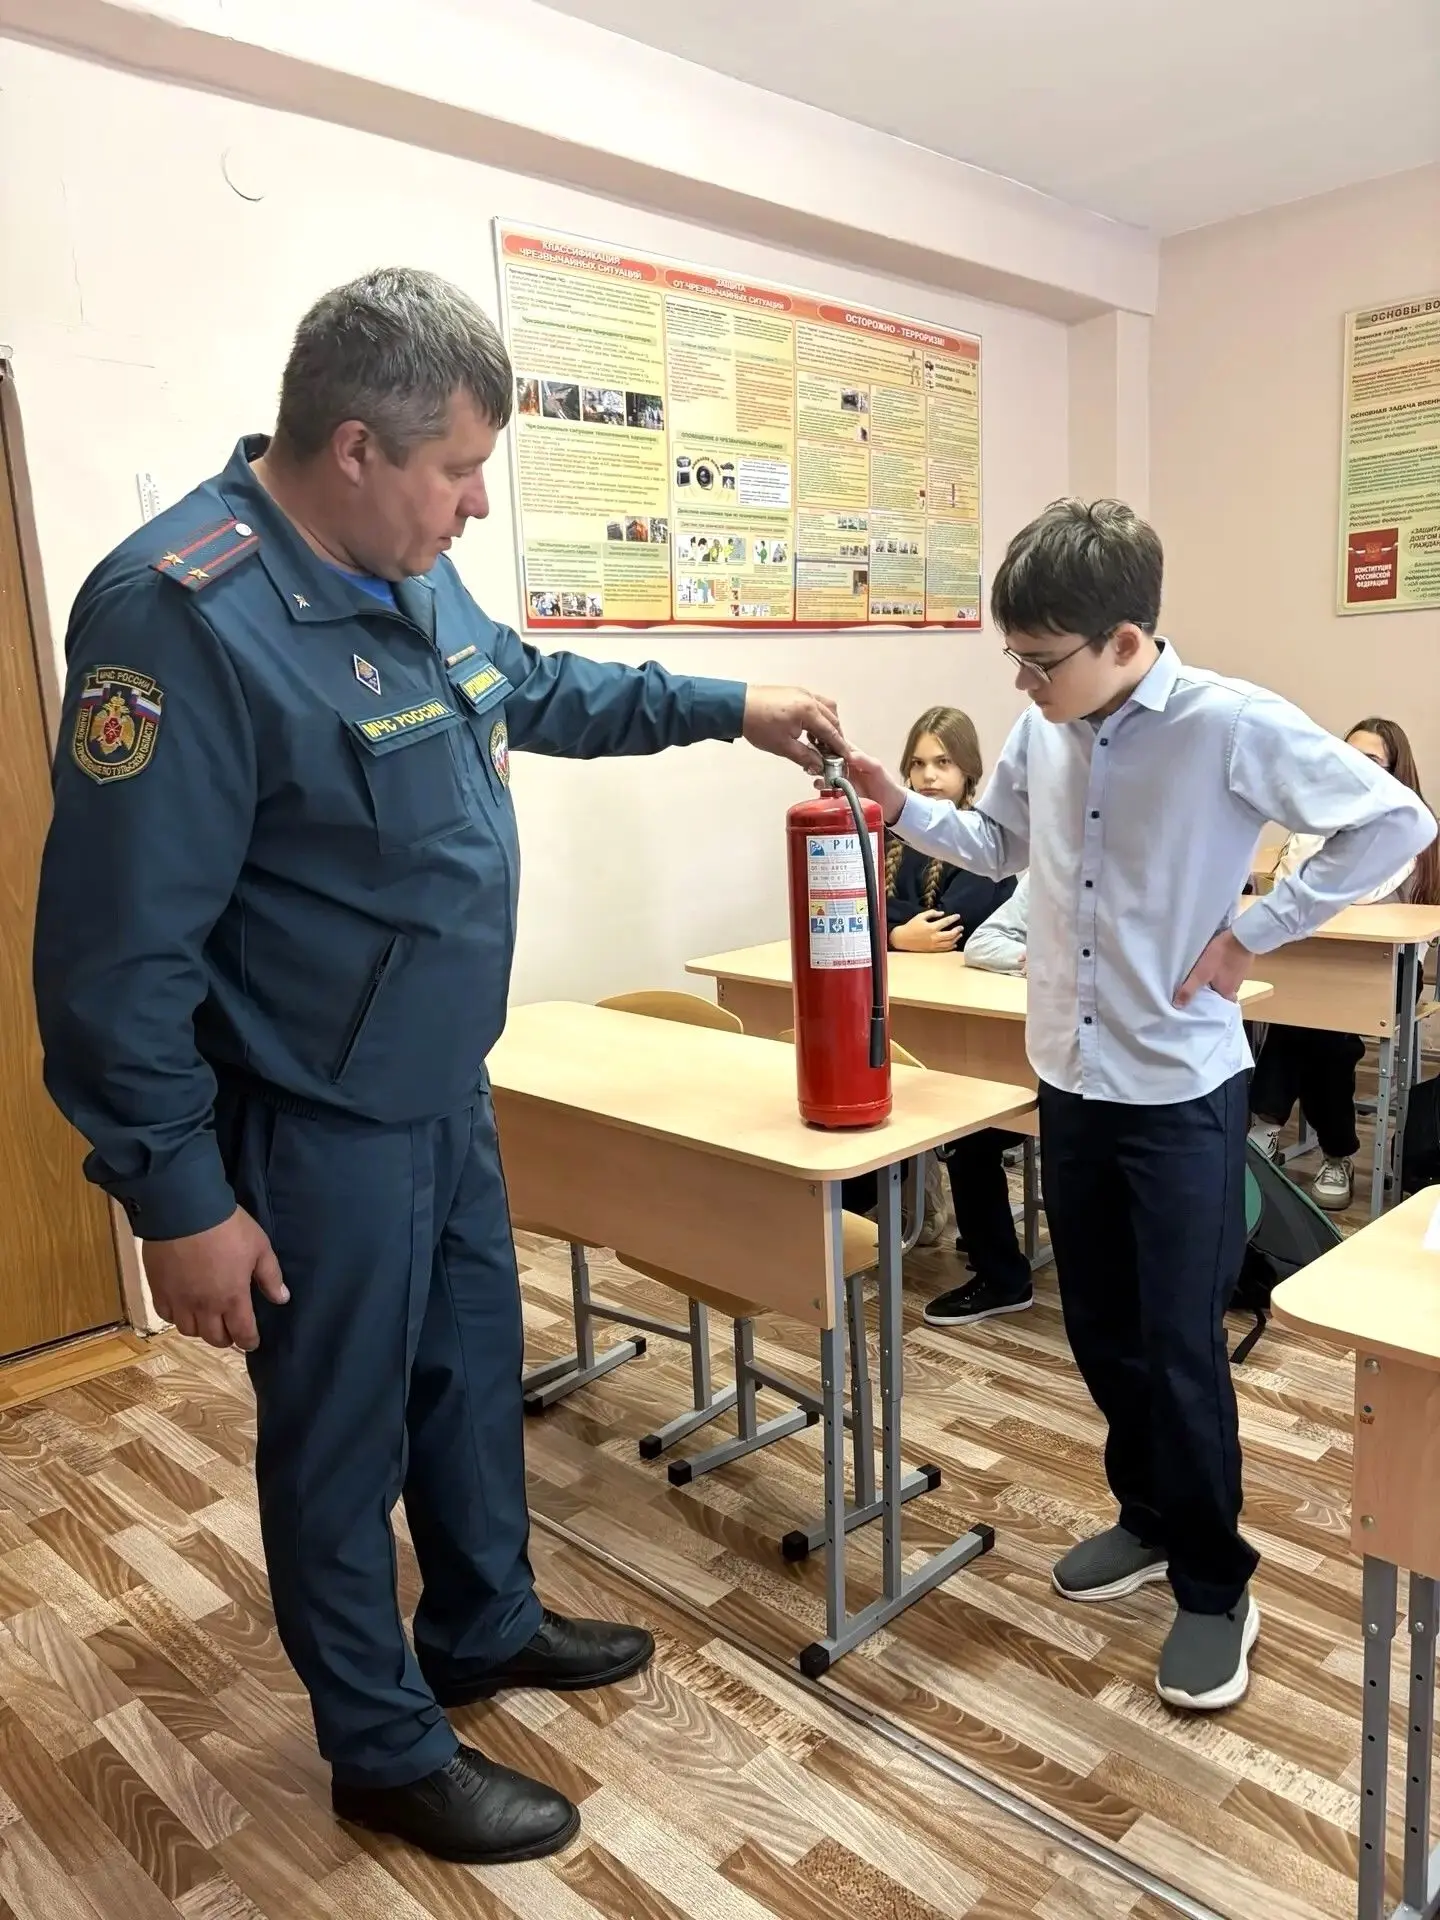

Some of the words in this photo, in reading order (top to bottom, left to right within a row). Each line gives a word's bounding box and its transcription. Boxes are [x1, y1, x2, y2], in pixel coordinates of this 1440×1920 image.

[542, 240, 621, 265] КЛАССИФИКАЦИЯ
[519, 248, 599, 271] ЧРЕЗВЫЧАЙНЫХ
[599, 265, 642, 280] СИТУАЦИЙ
[673, 280, 685, 289] ОТ
[685, 281, 748, 302] ЧРЕЗВЫЧАЙНЫХ
[748, 295, 785, 310] СИТУАЦИЙ
[1370, 304, 1421, 322] ОСНОВЫ
[1425, 300, 1440, 311] ВО
[845, 313, 896, 334] ОСТОРОЖНО
[1350, 407, 1388, 419] ОСНОВНАЯ
[1388, 402, 1416, 412] ЗАДАЧА
[1409, 533, 1437, 543] ДОЛГОМ
[1354, 563, 1392, 575] КОНСТИТУЦИЯ
[1355, 570, 1391, 582] РОССИЙСКОЙ
[1356, 578, 1389, 588] ФЕДЕРАЦИИ
[117, 672, 151, 691] РОССИИ
[362, 719, 397, 738] МЧС
[395, 701, 449, 728] РОССИИ
